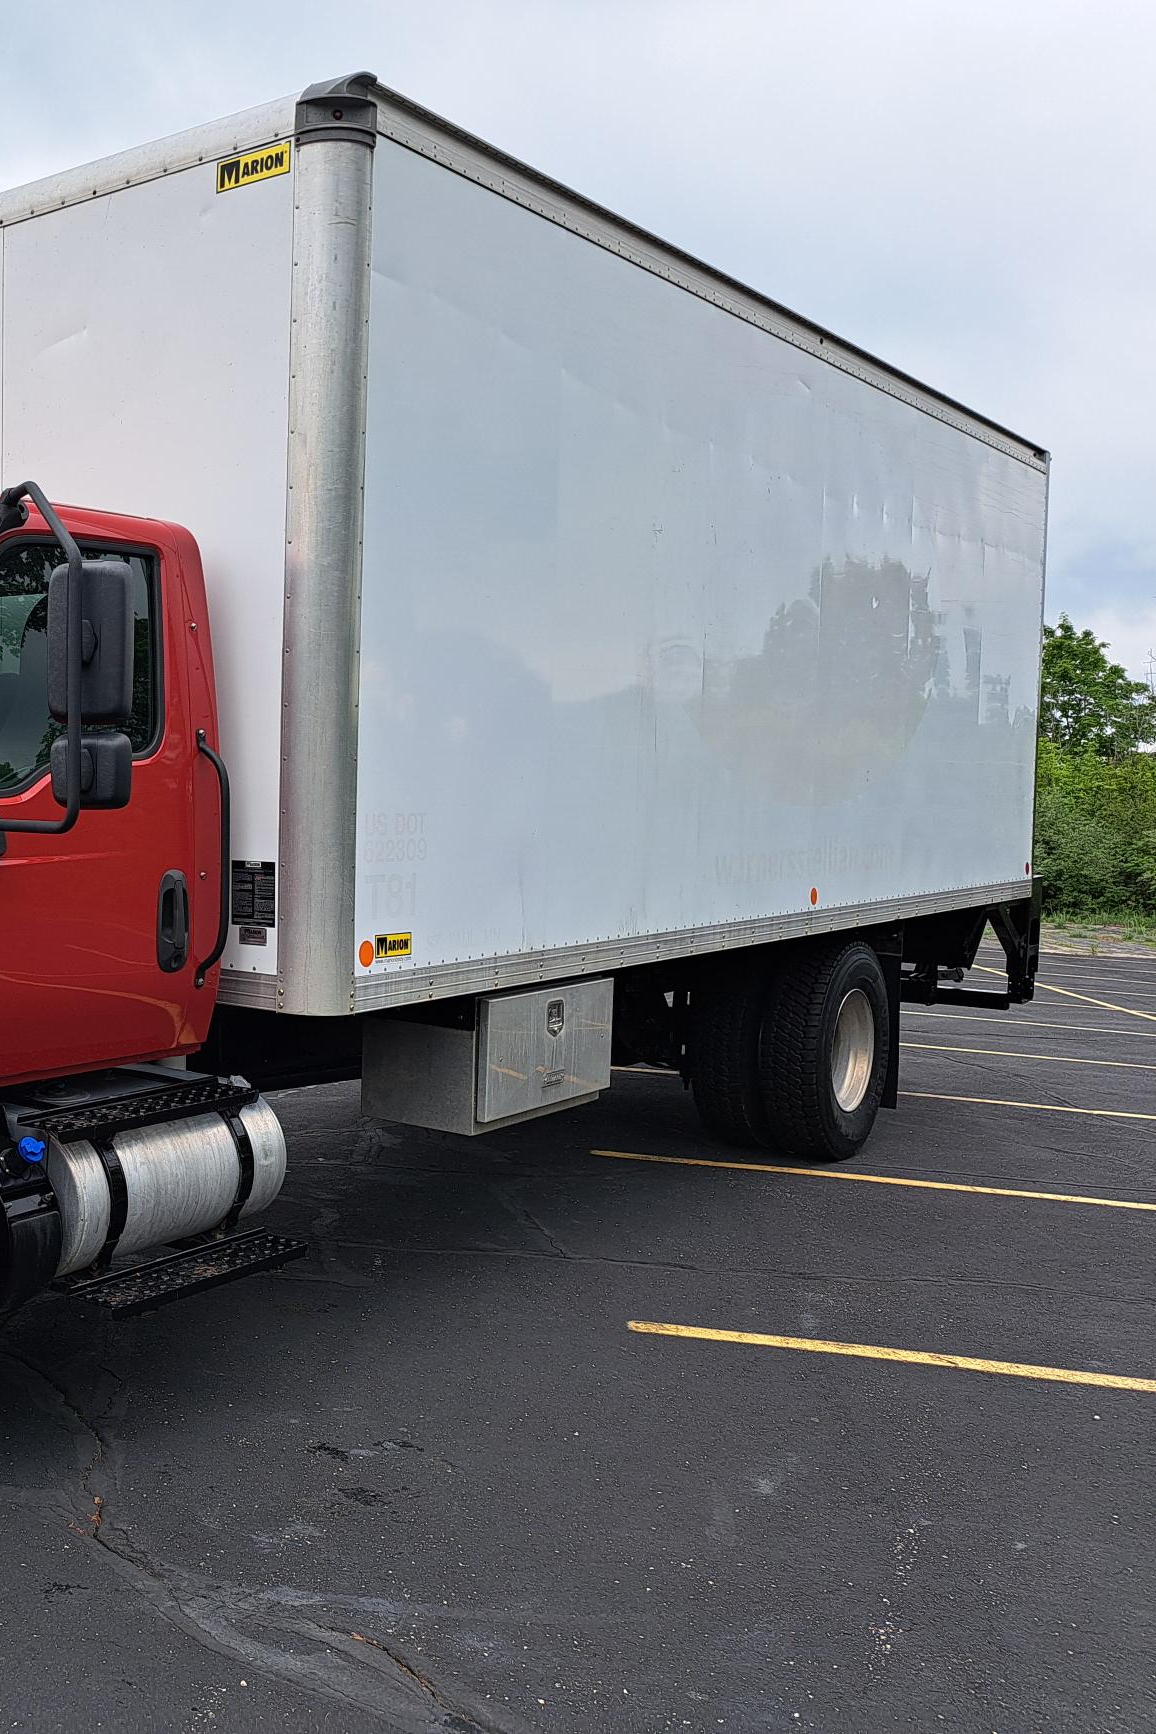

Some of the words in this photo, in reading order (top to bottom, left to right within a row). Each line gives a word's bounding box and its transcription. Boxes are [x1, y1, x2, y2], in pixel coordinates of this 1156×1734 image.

[219, 151, 284, 189] MARION
[395, 812, 427, 836] DOT
[377, 937, 408, 955] MARION
